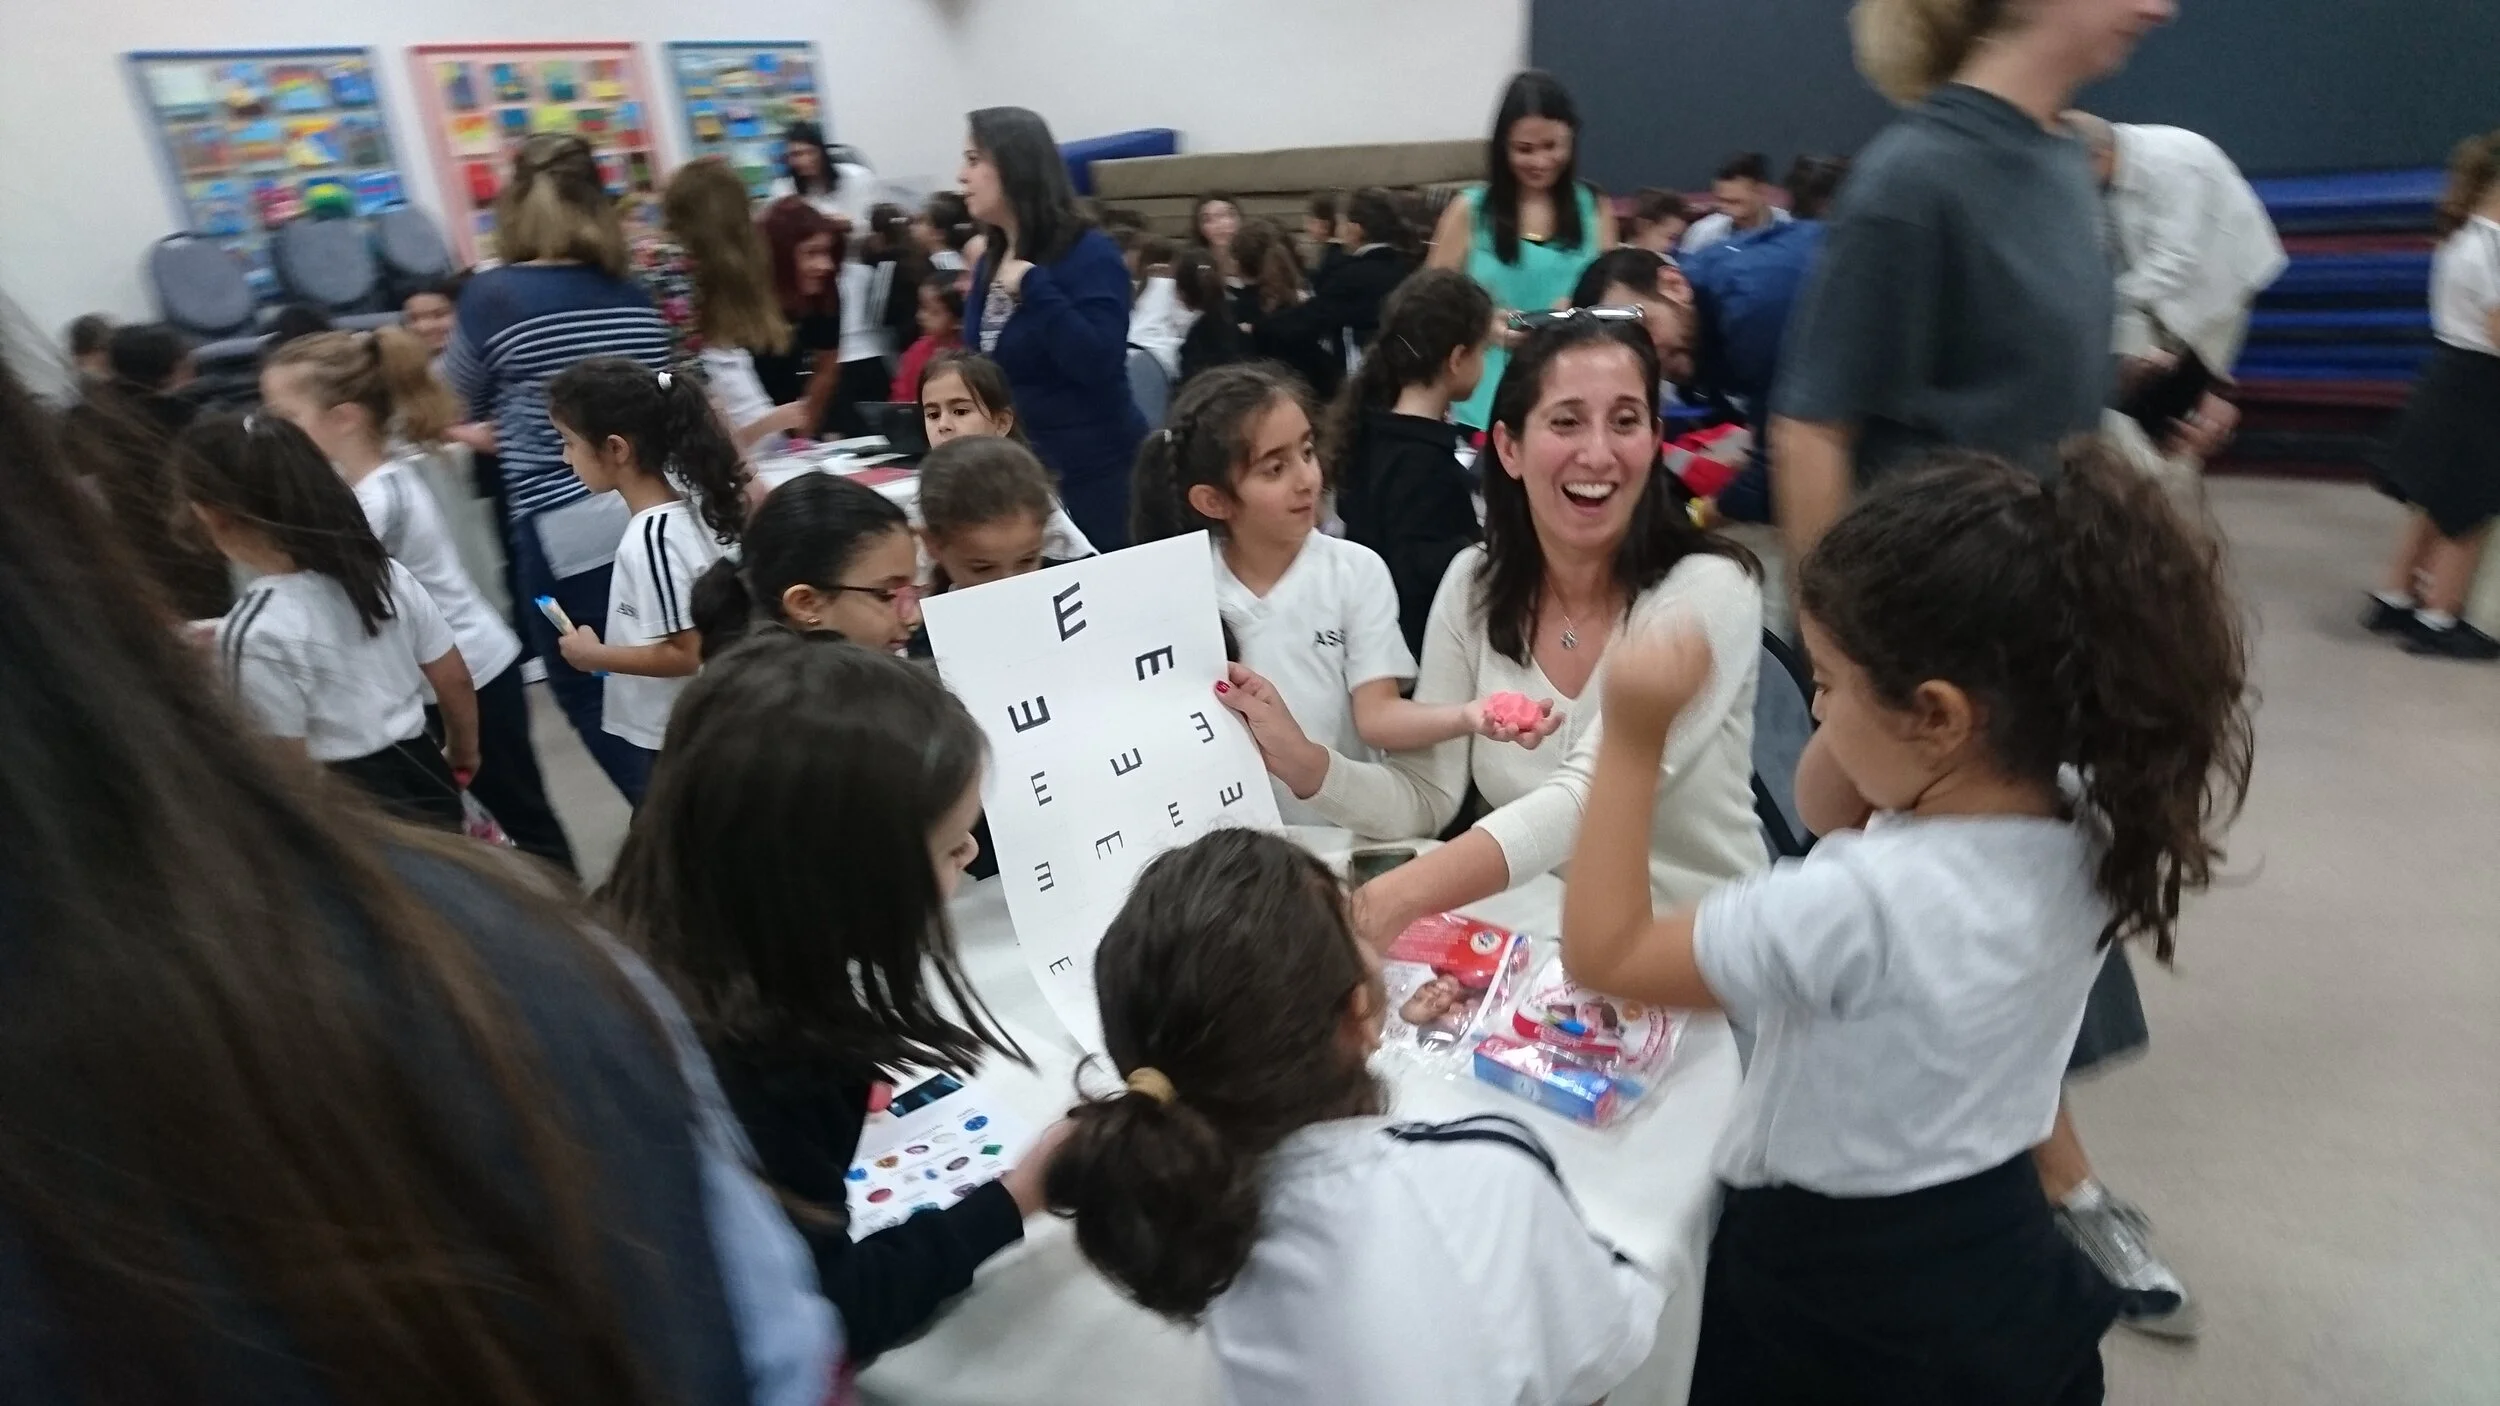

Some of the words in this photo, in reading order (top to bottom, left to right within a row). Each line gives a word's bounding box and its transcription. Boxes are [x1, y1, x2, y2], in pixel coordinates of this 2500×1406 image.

[1052, 582, 1087, 642] E
[1135, 645, 1174, 681] E
[1007, 696, 1051, 733] E
